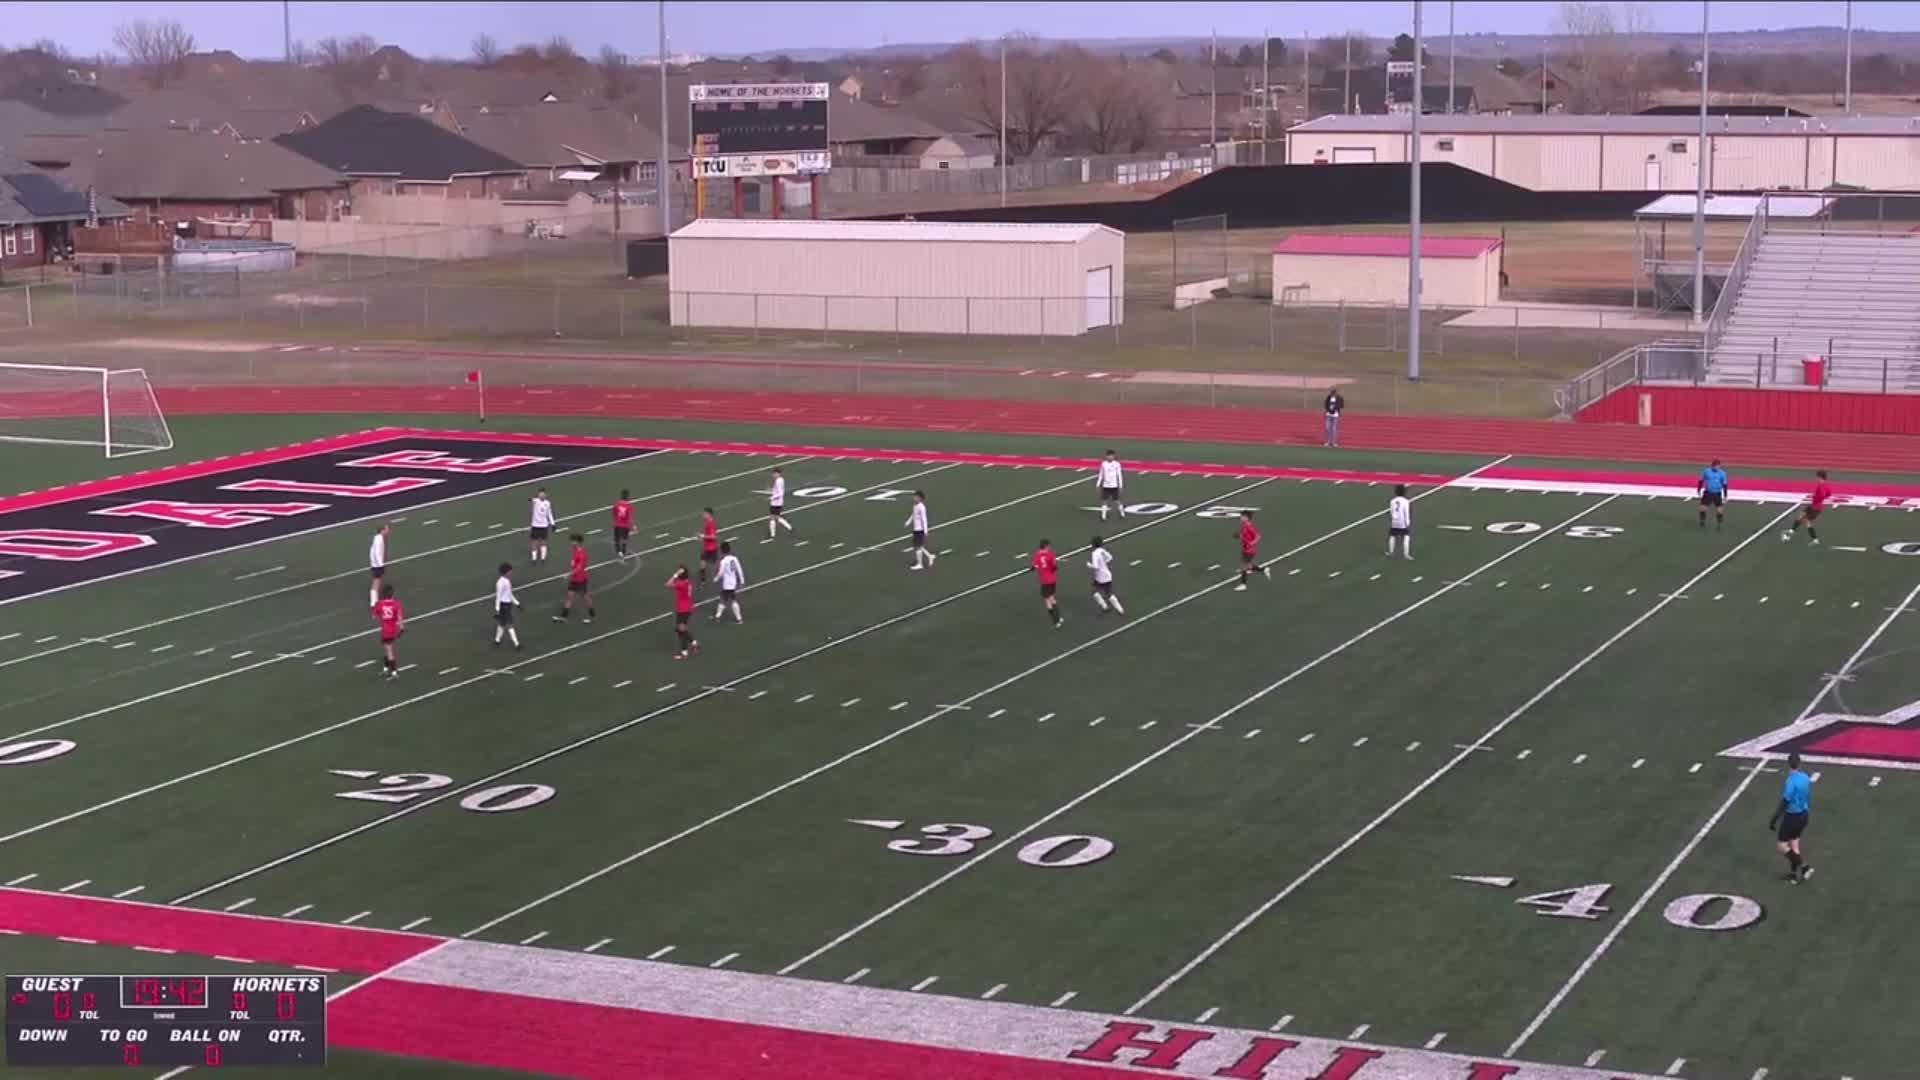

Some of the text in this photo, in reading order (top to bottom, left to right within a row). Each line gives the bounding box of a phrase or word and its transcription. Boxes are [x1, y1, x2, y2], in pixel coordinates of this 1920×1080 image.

[707, 86, 812, 97] HOME OF THE HORNETS
[0, 449, 552, 578] DALE
